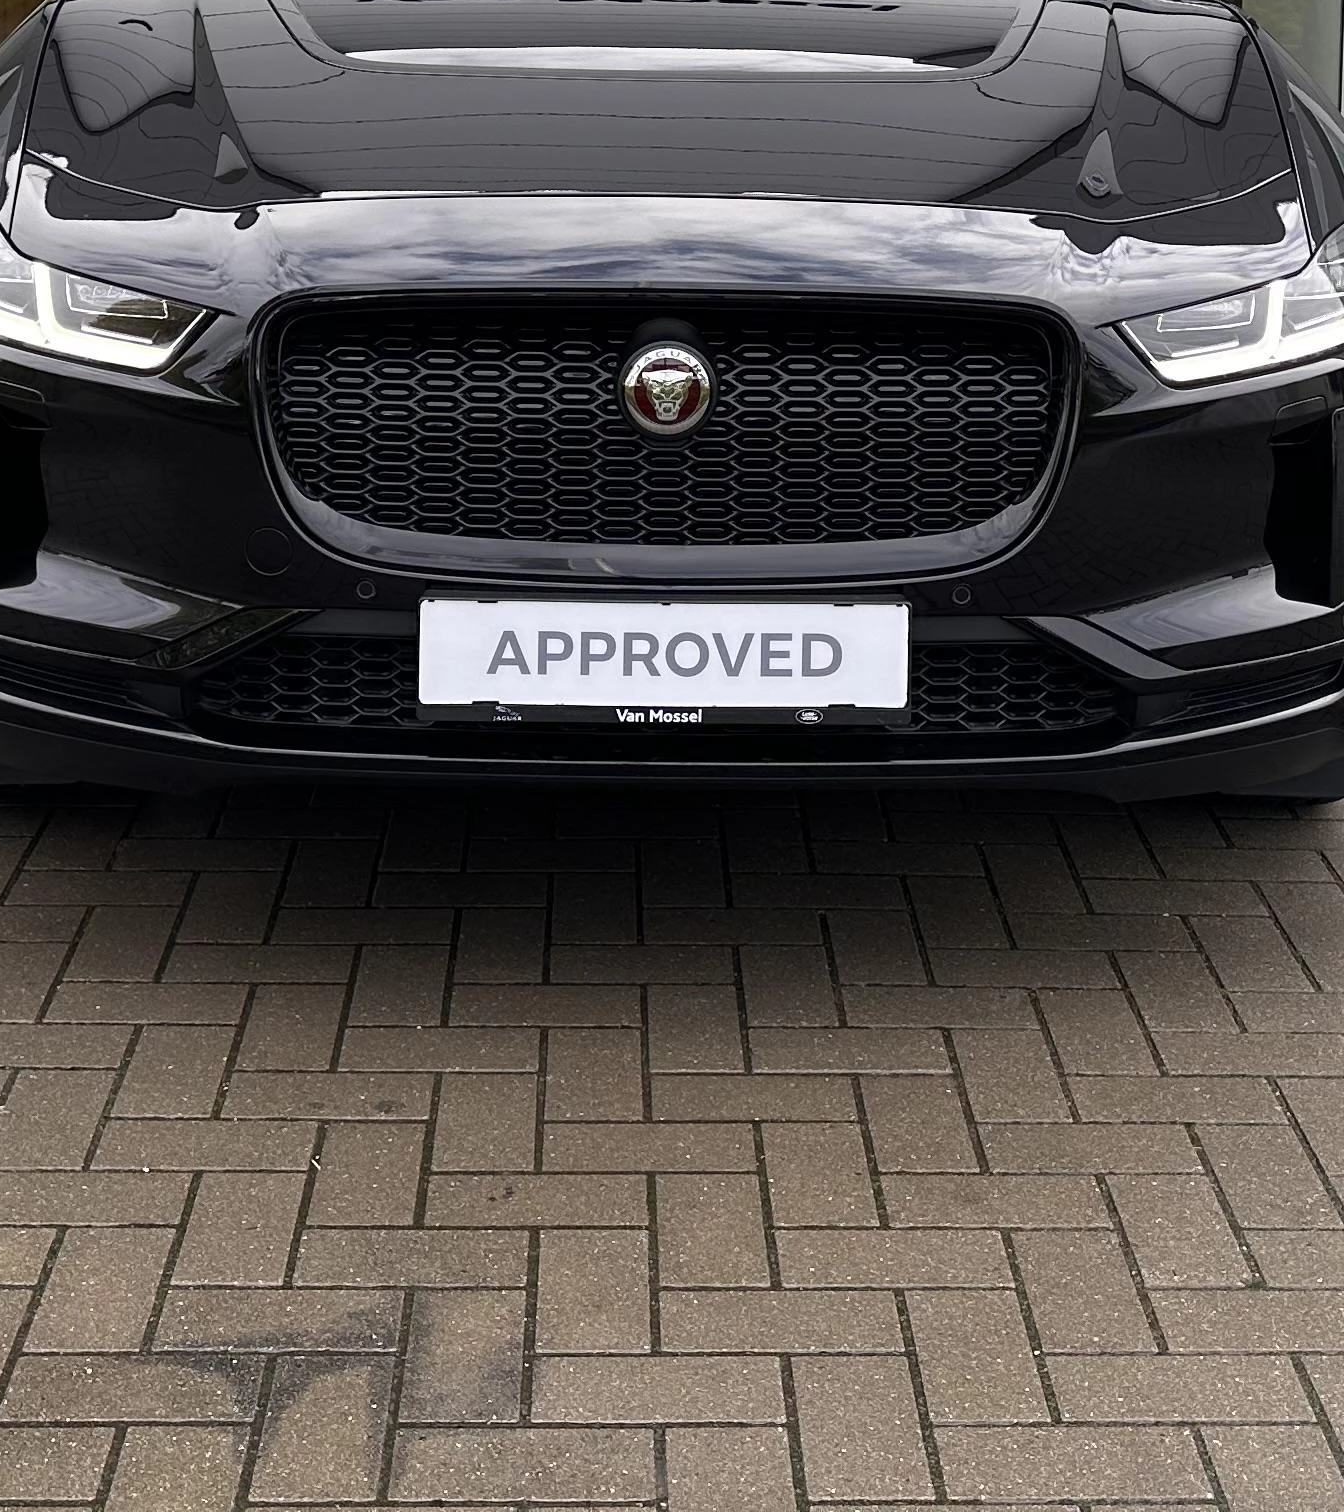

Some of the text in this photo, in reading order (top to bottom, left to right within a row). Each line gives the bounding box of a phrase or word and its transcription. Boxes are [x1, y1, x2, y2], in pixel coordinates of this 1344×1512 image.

[633, 350, 703, 374] JAGUAR
[486, 630, 844, 678] APPROVED
[615, 709, 703, 723] Van Mossel
